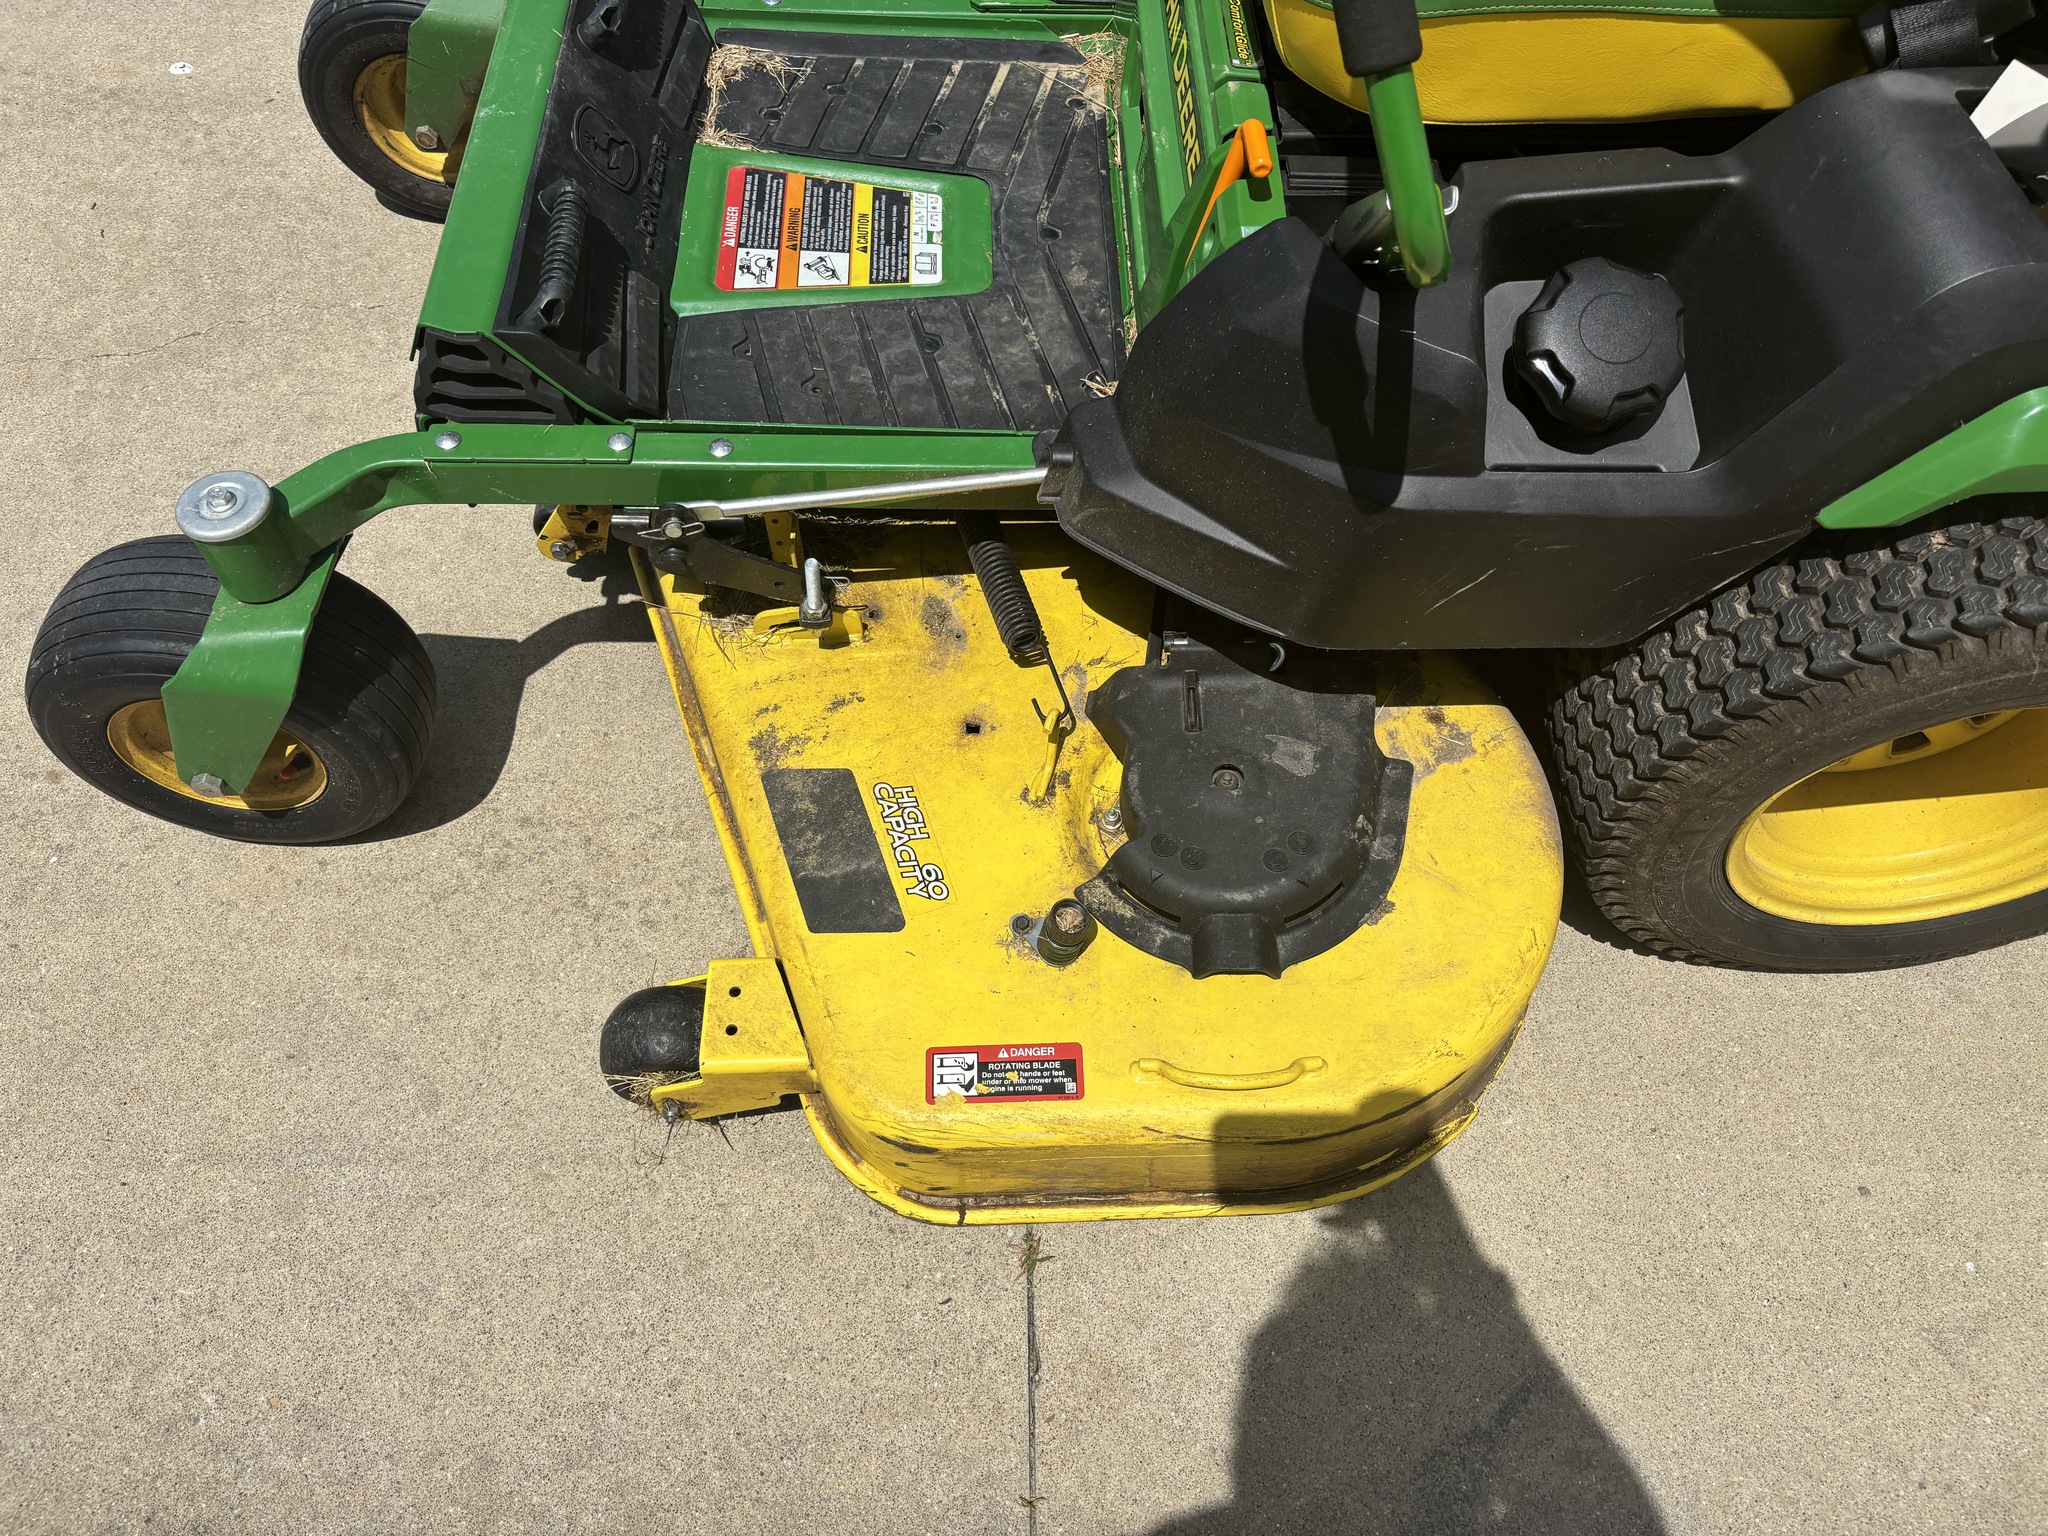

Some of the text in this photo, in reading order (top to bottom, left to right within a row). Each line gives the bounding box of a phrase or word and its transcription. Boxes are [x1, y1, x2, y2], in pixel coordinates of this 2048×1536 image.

[1174, 30, 1200, 188] DEERE
[635, 133, 669, 254] JOHN DEERE
[724, 206, 738, 236] DANGER
[786, 207, 800, 242] WARNING
[856, 213, 869, 244] CAUTION
[873, 781, 932, 900] CAPACITY
[894, 786, 949, 900] HIGH 60
[1010, 1047, 1055, 1057] DANGER
